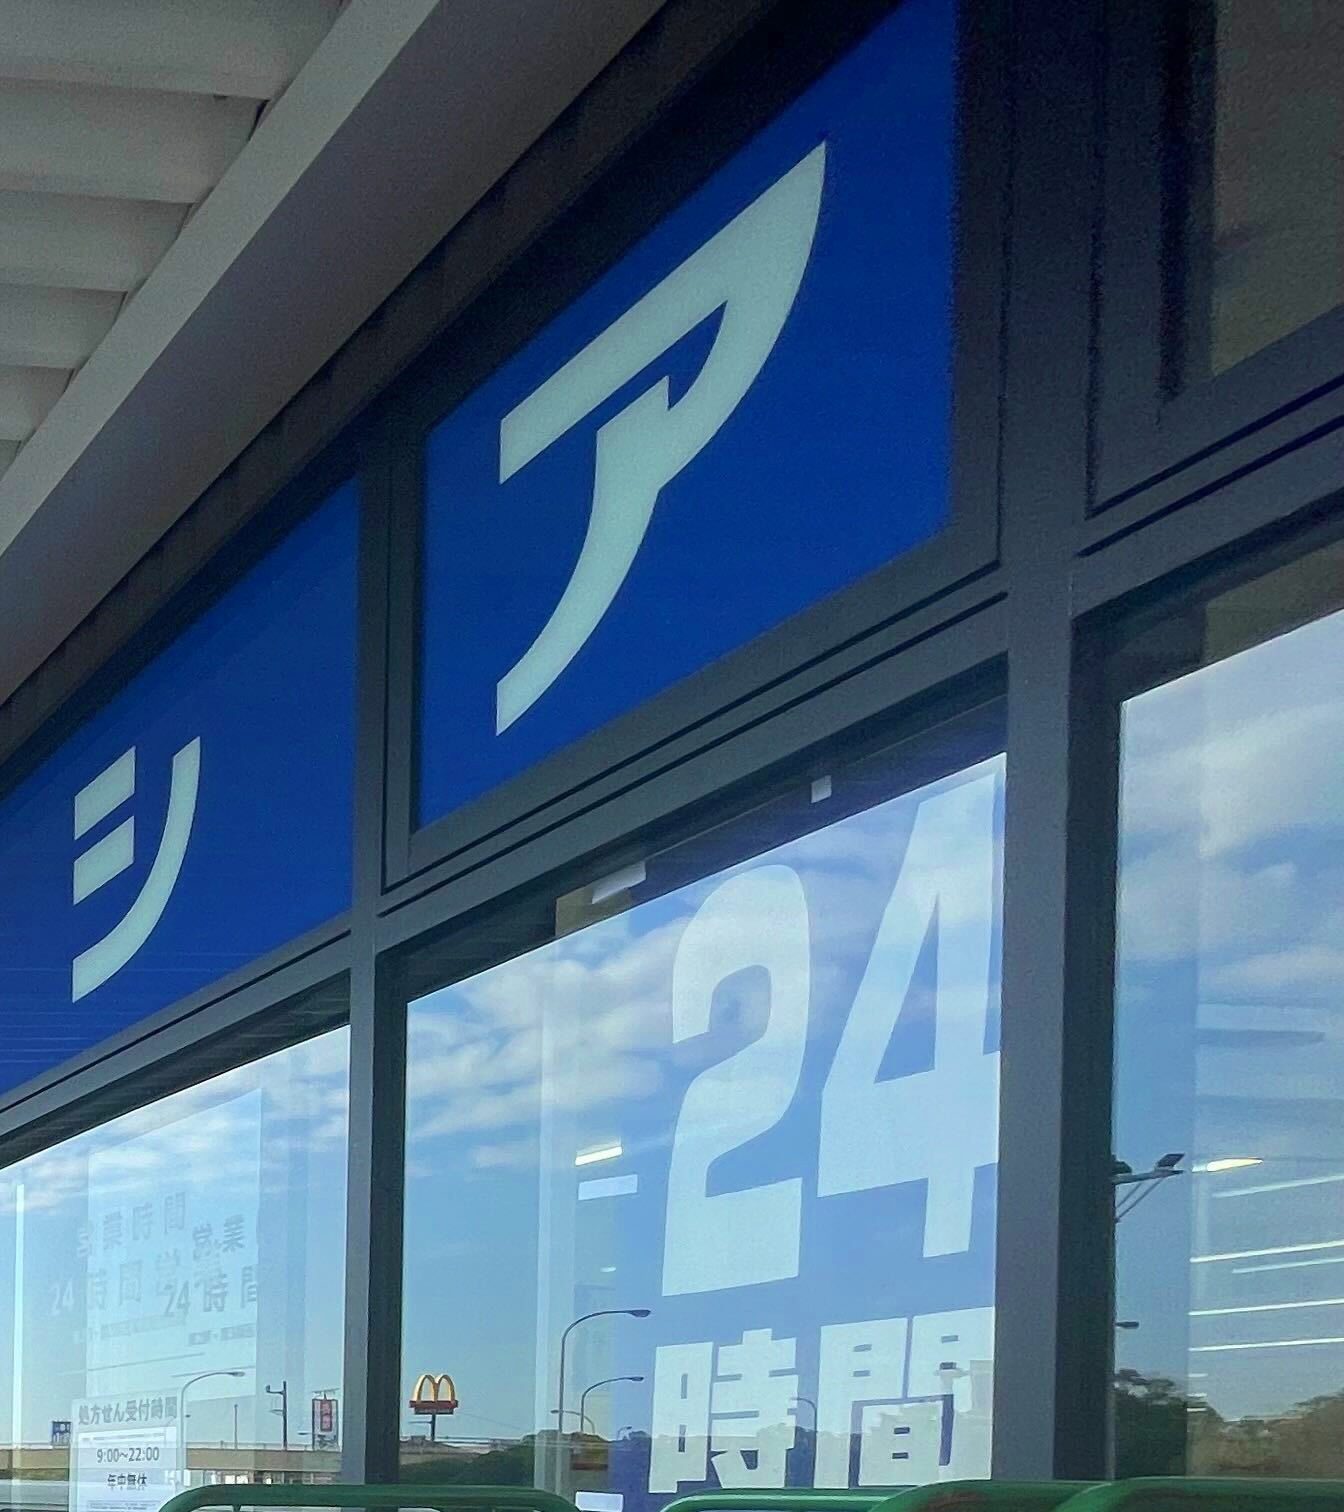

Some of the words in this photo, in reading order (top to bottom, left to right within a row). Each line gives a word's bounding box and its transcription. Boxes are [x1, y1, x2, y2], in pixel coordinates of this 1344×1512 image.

[663, 757, 1006, 1296] 24
[78, 1396, 177, 1425] 処方せん受付時間
[649, 1308, 994, 1493] 時間
